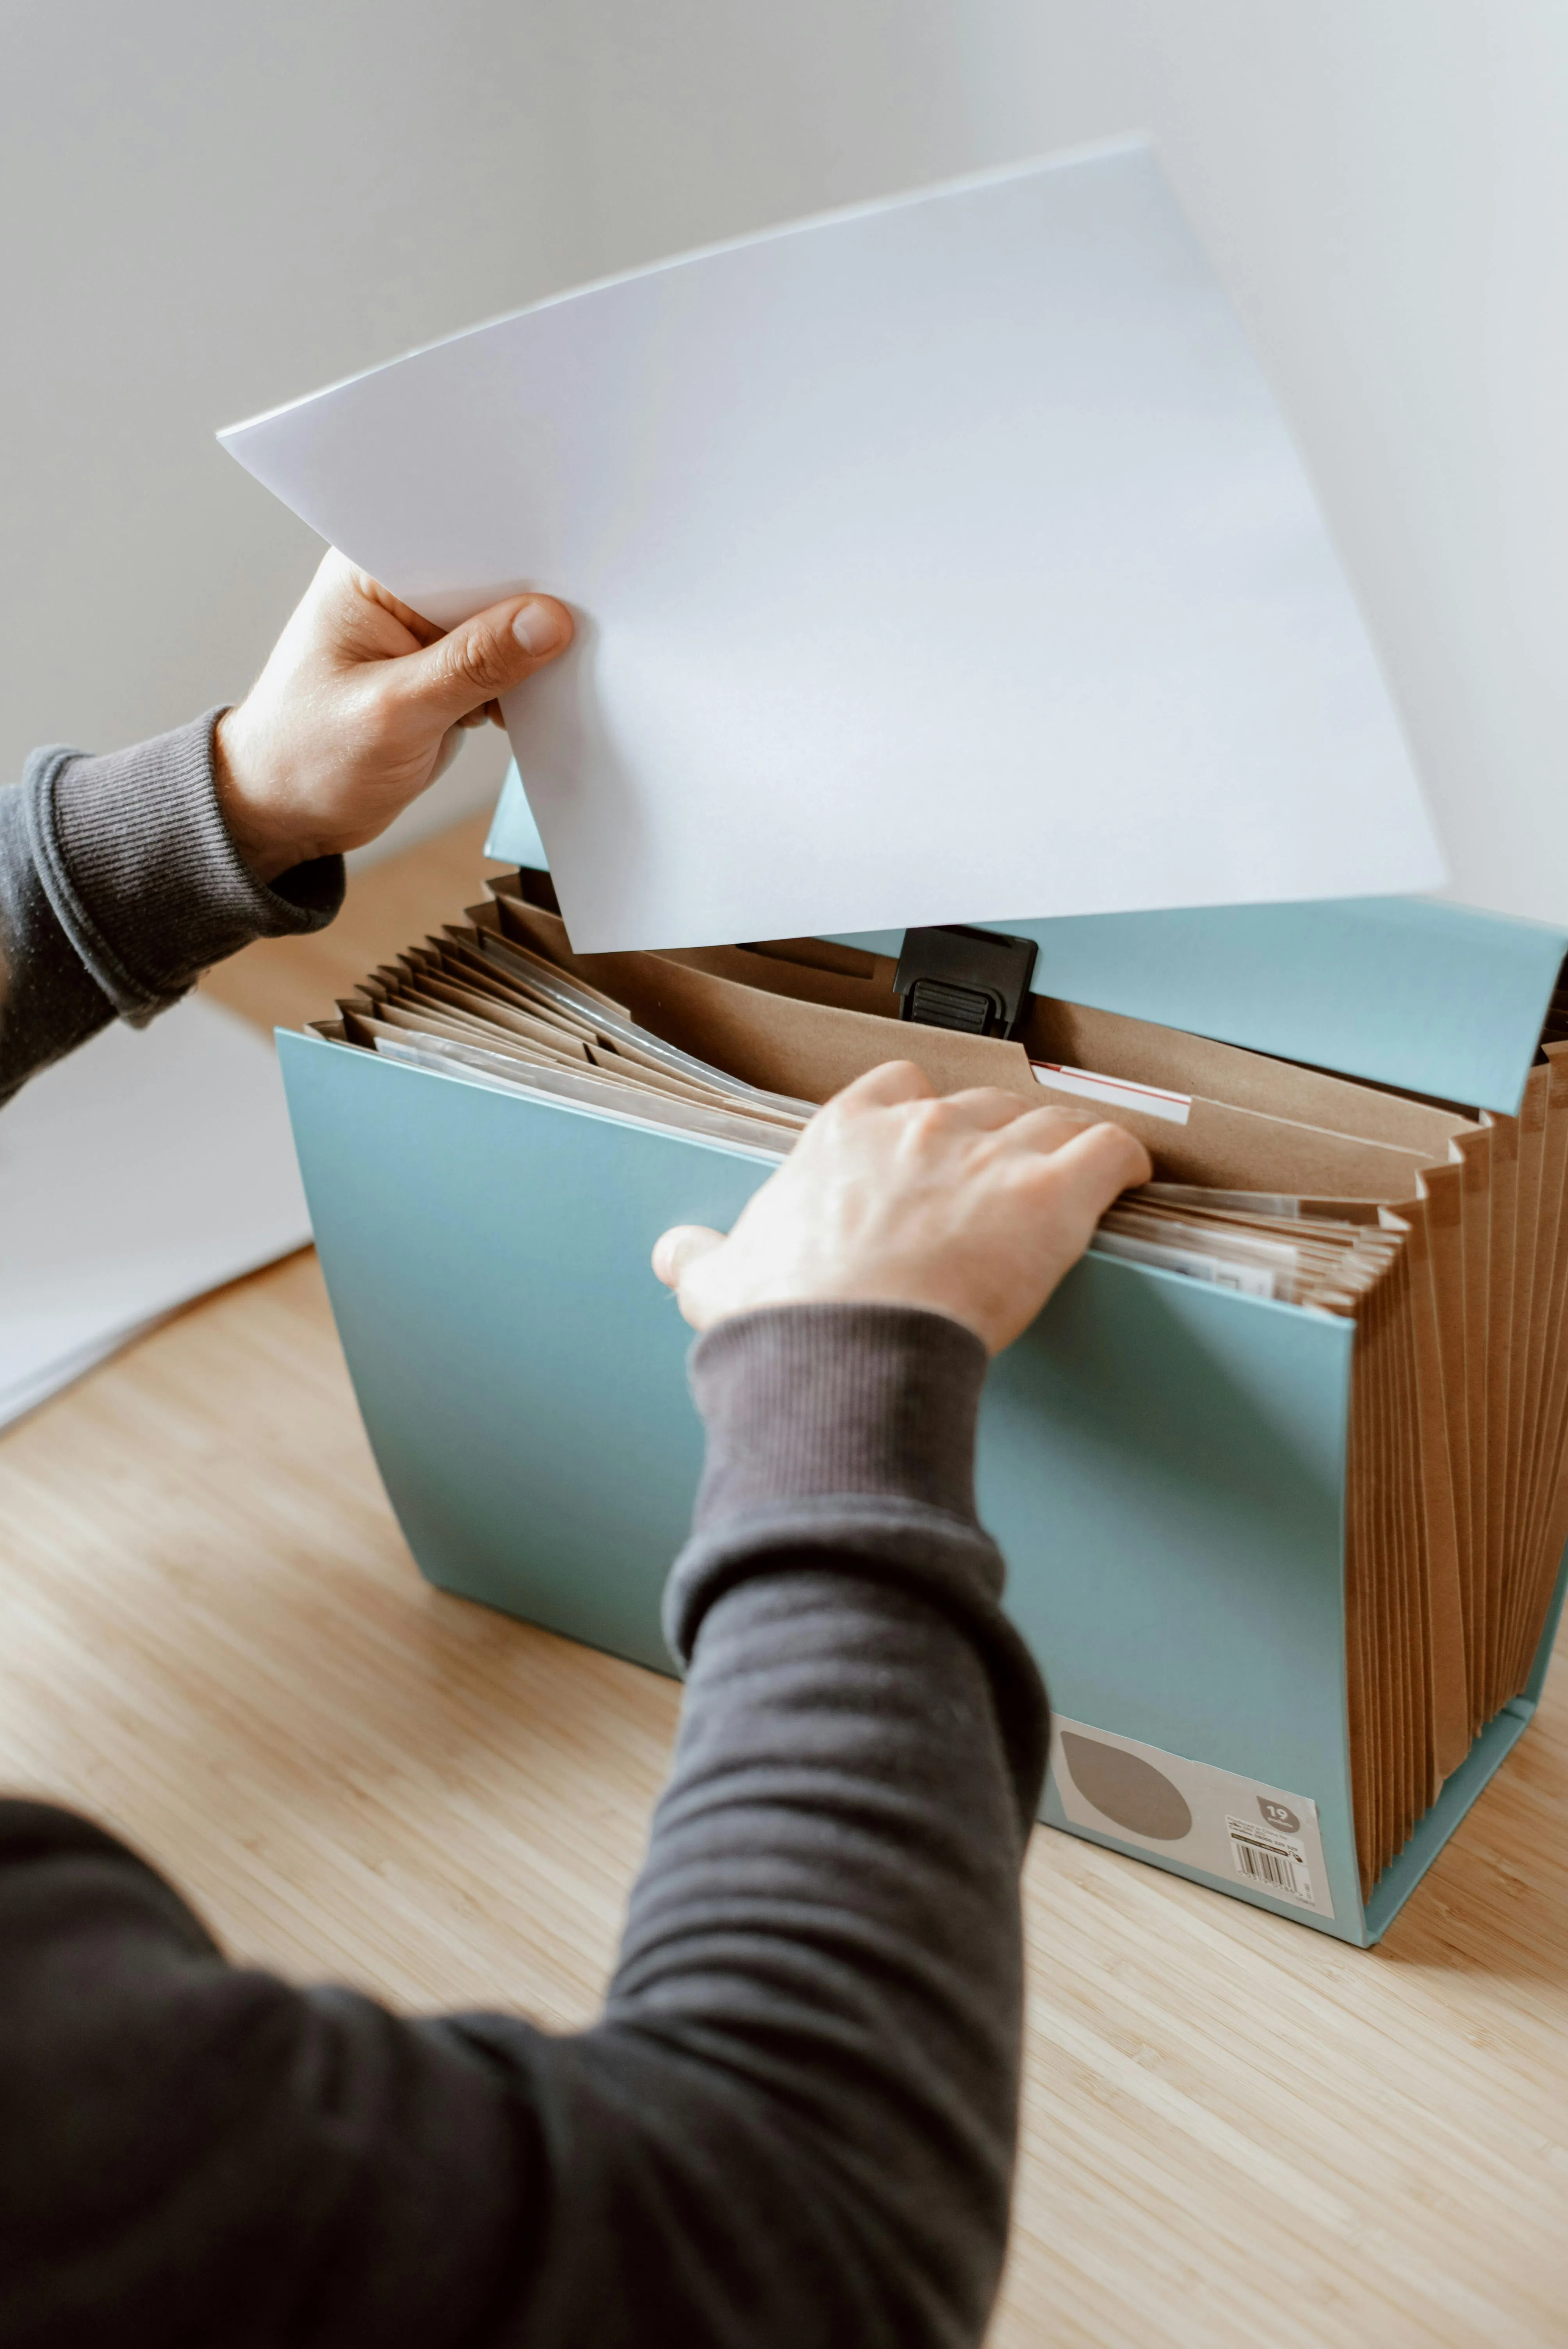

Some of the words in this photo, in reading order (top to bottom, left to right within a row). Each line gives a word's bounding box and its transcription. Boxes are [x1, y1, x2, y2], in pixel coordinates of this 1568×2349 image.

[1266, 1805, 1288, 1820] 19
[1227, 1816, 1254, 1829] Produced
[1262, 1829, 1278, 1837] China
